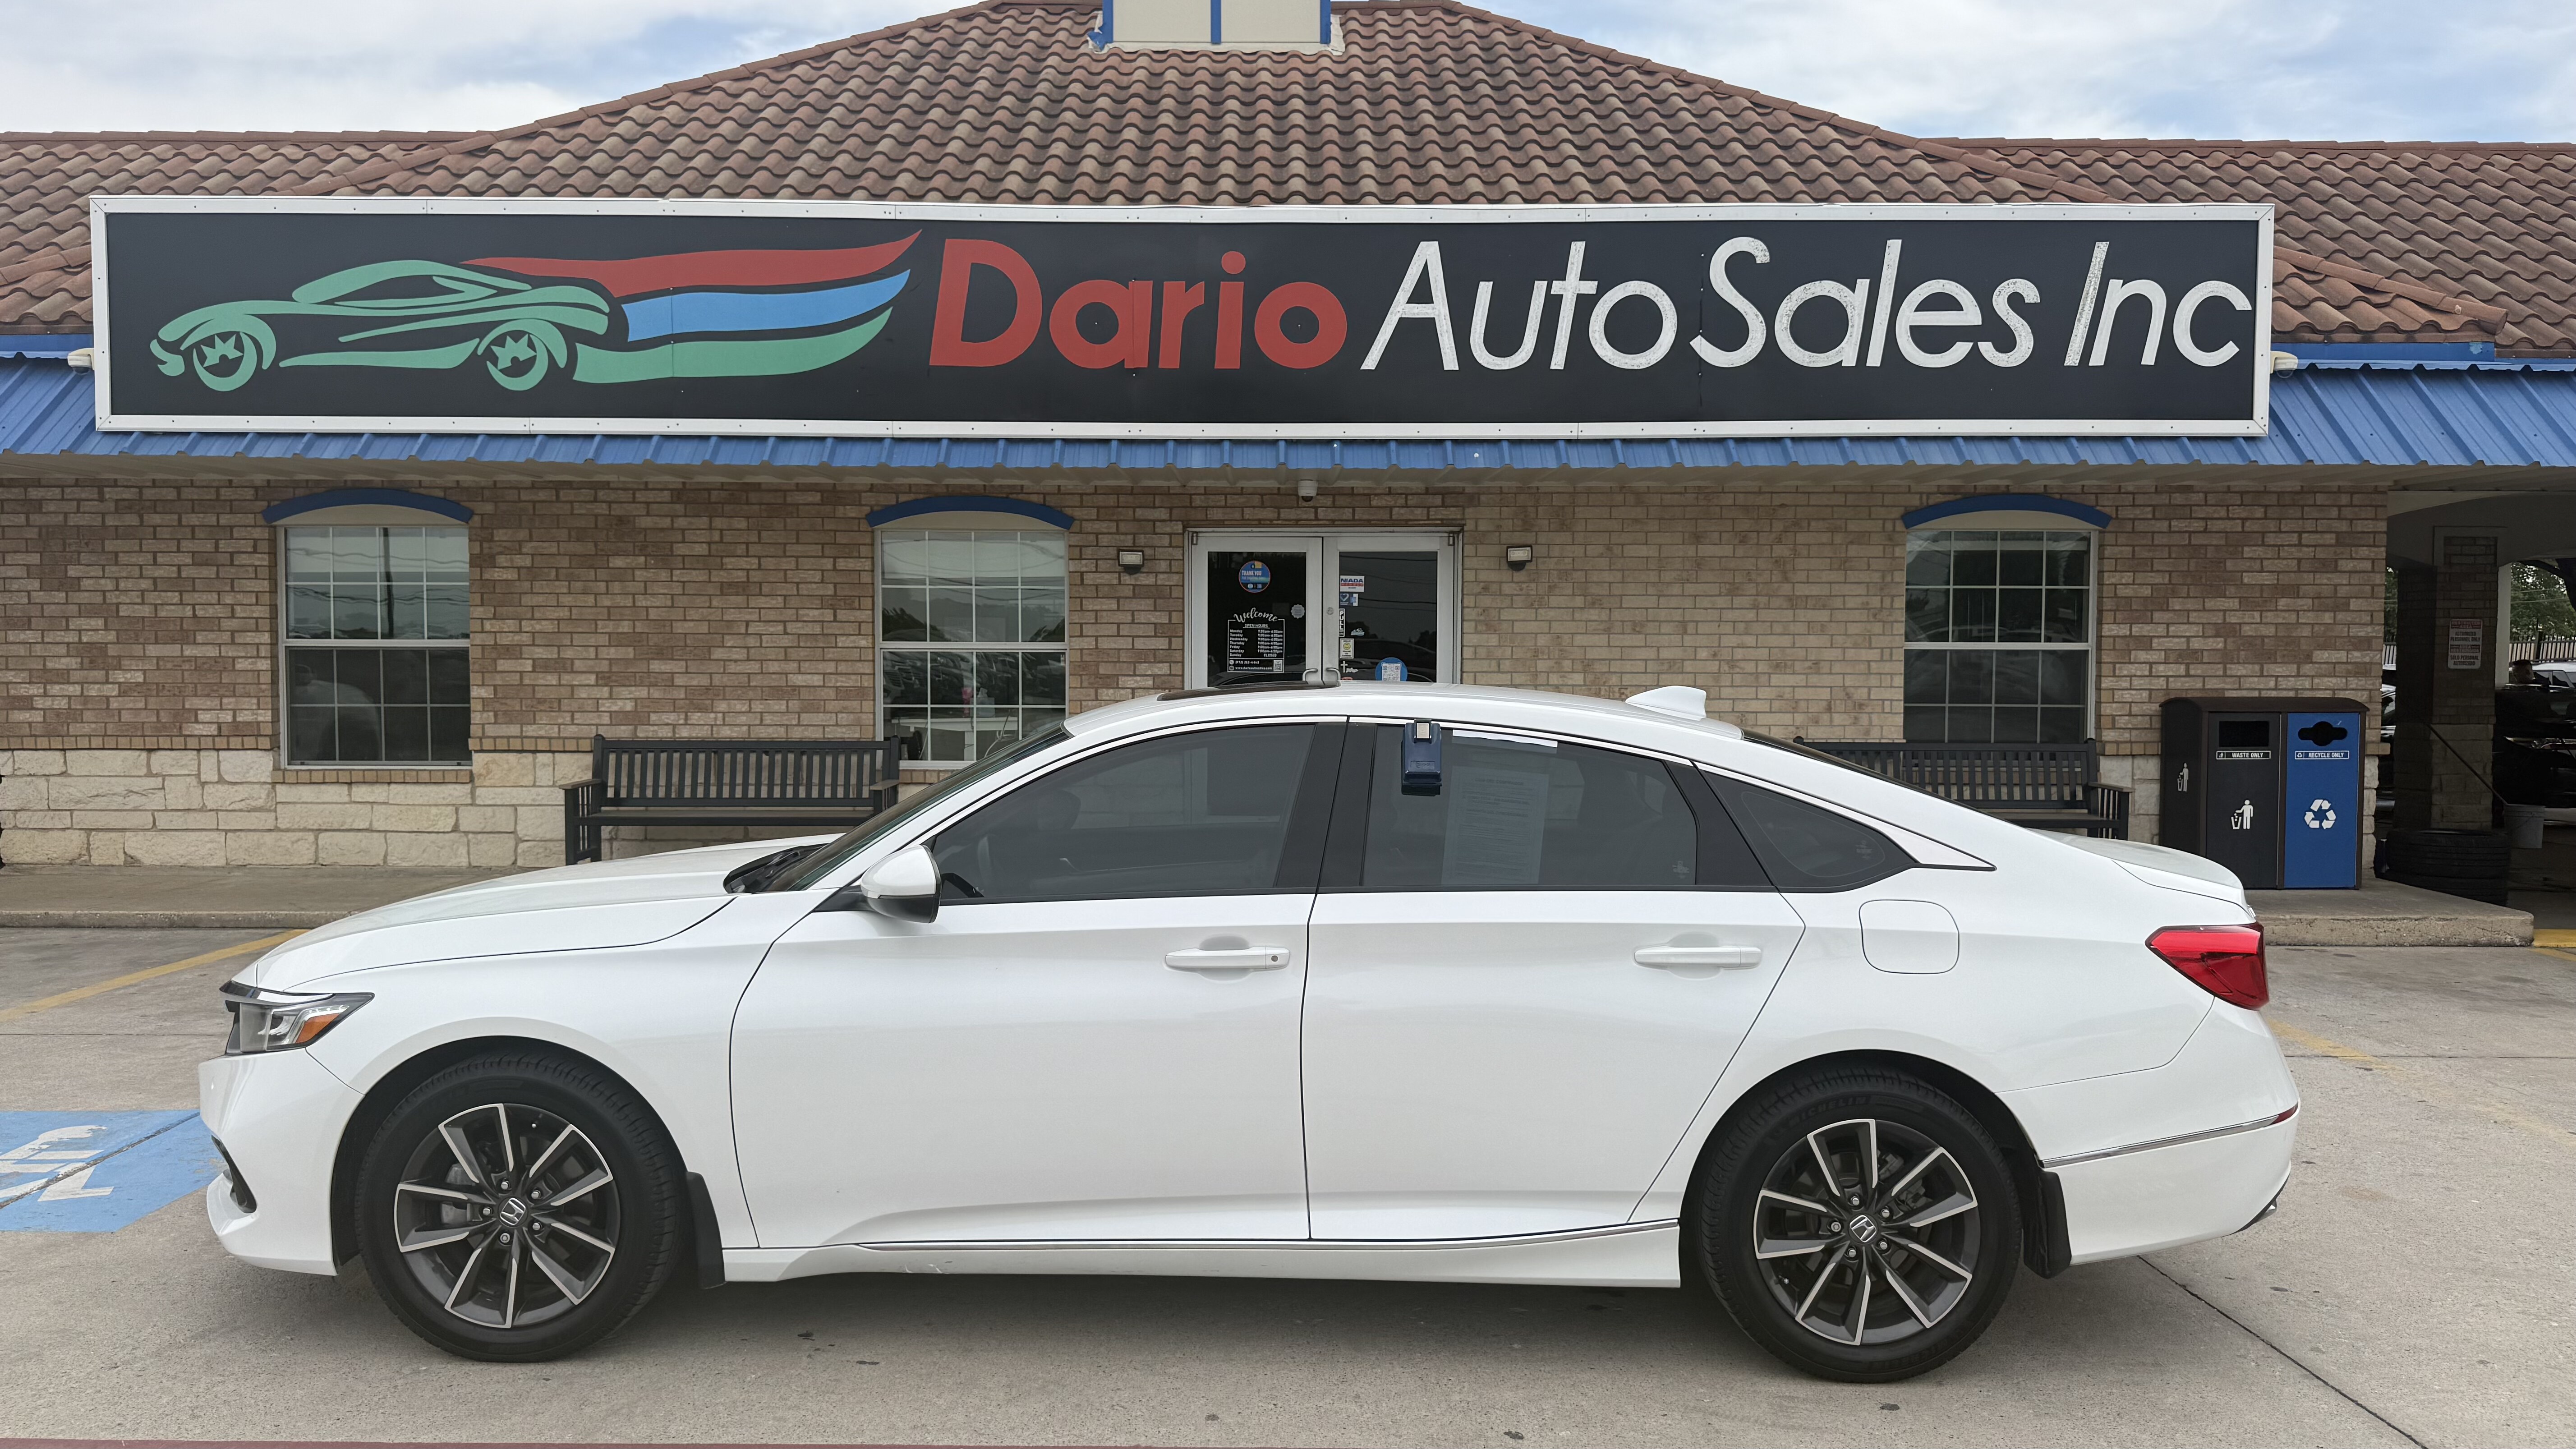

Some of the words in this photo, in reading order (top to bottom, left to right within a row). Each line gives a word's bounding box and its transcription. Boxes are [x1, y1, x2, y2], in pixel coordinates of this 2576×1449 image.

[929, 238, 1348, 369] Dario
[1360, 240, 1678, 370] Auto
[1689, 236, 2041, 368] Sales
[2064, 241, 2252, 367] Inc
[1233, 607, 1278, 623] Welcome
[1789, 1096, 1870, 1127] MICHELIN
